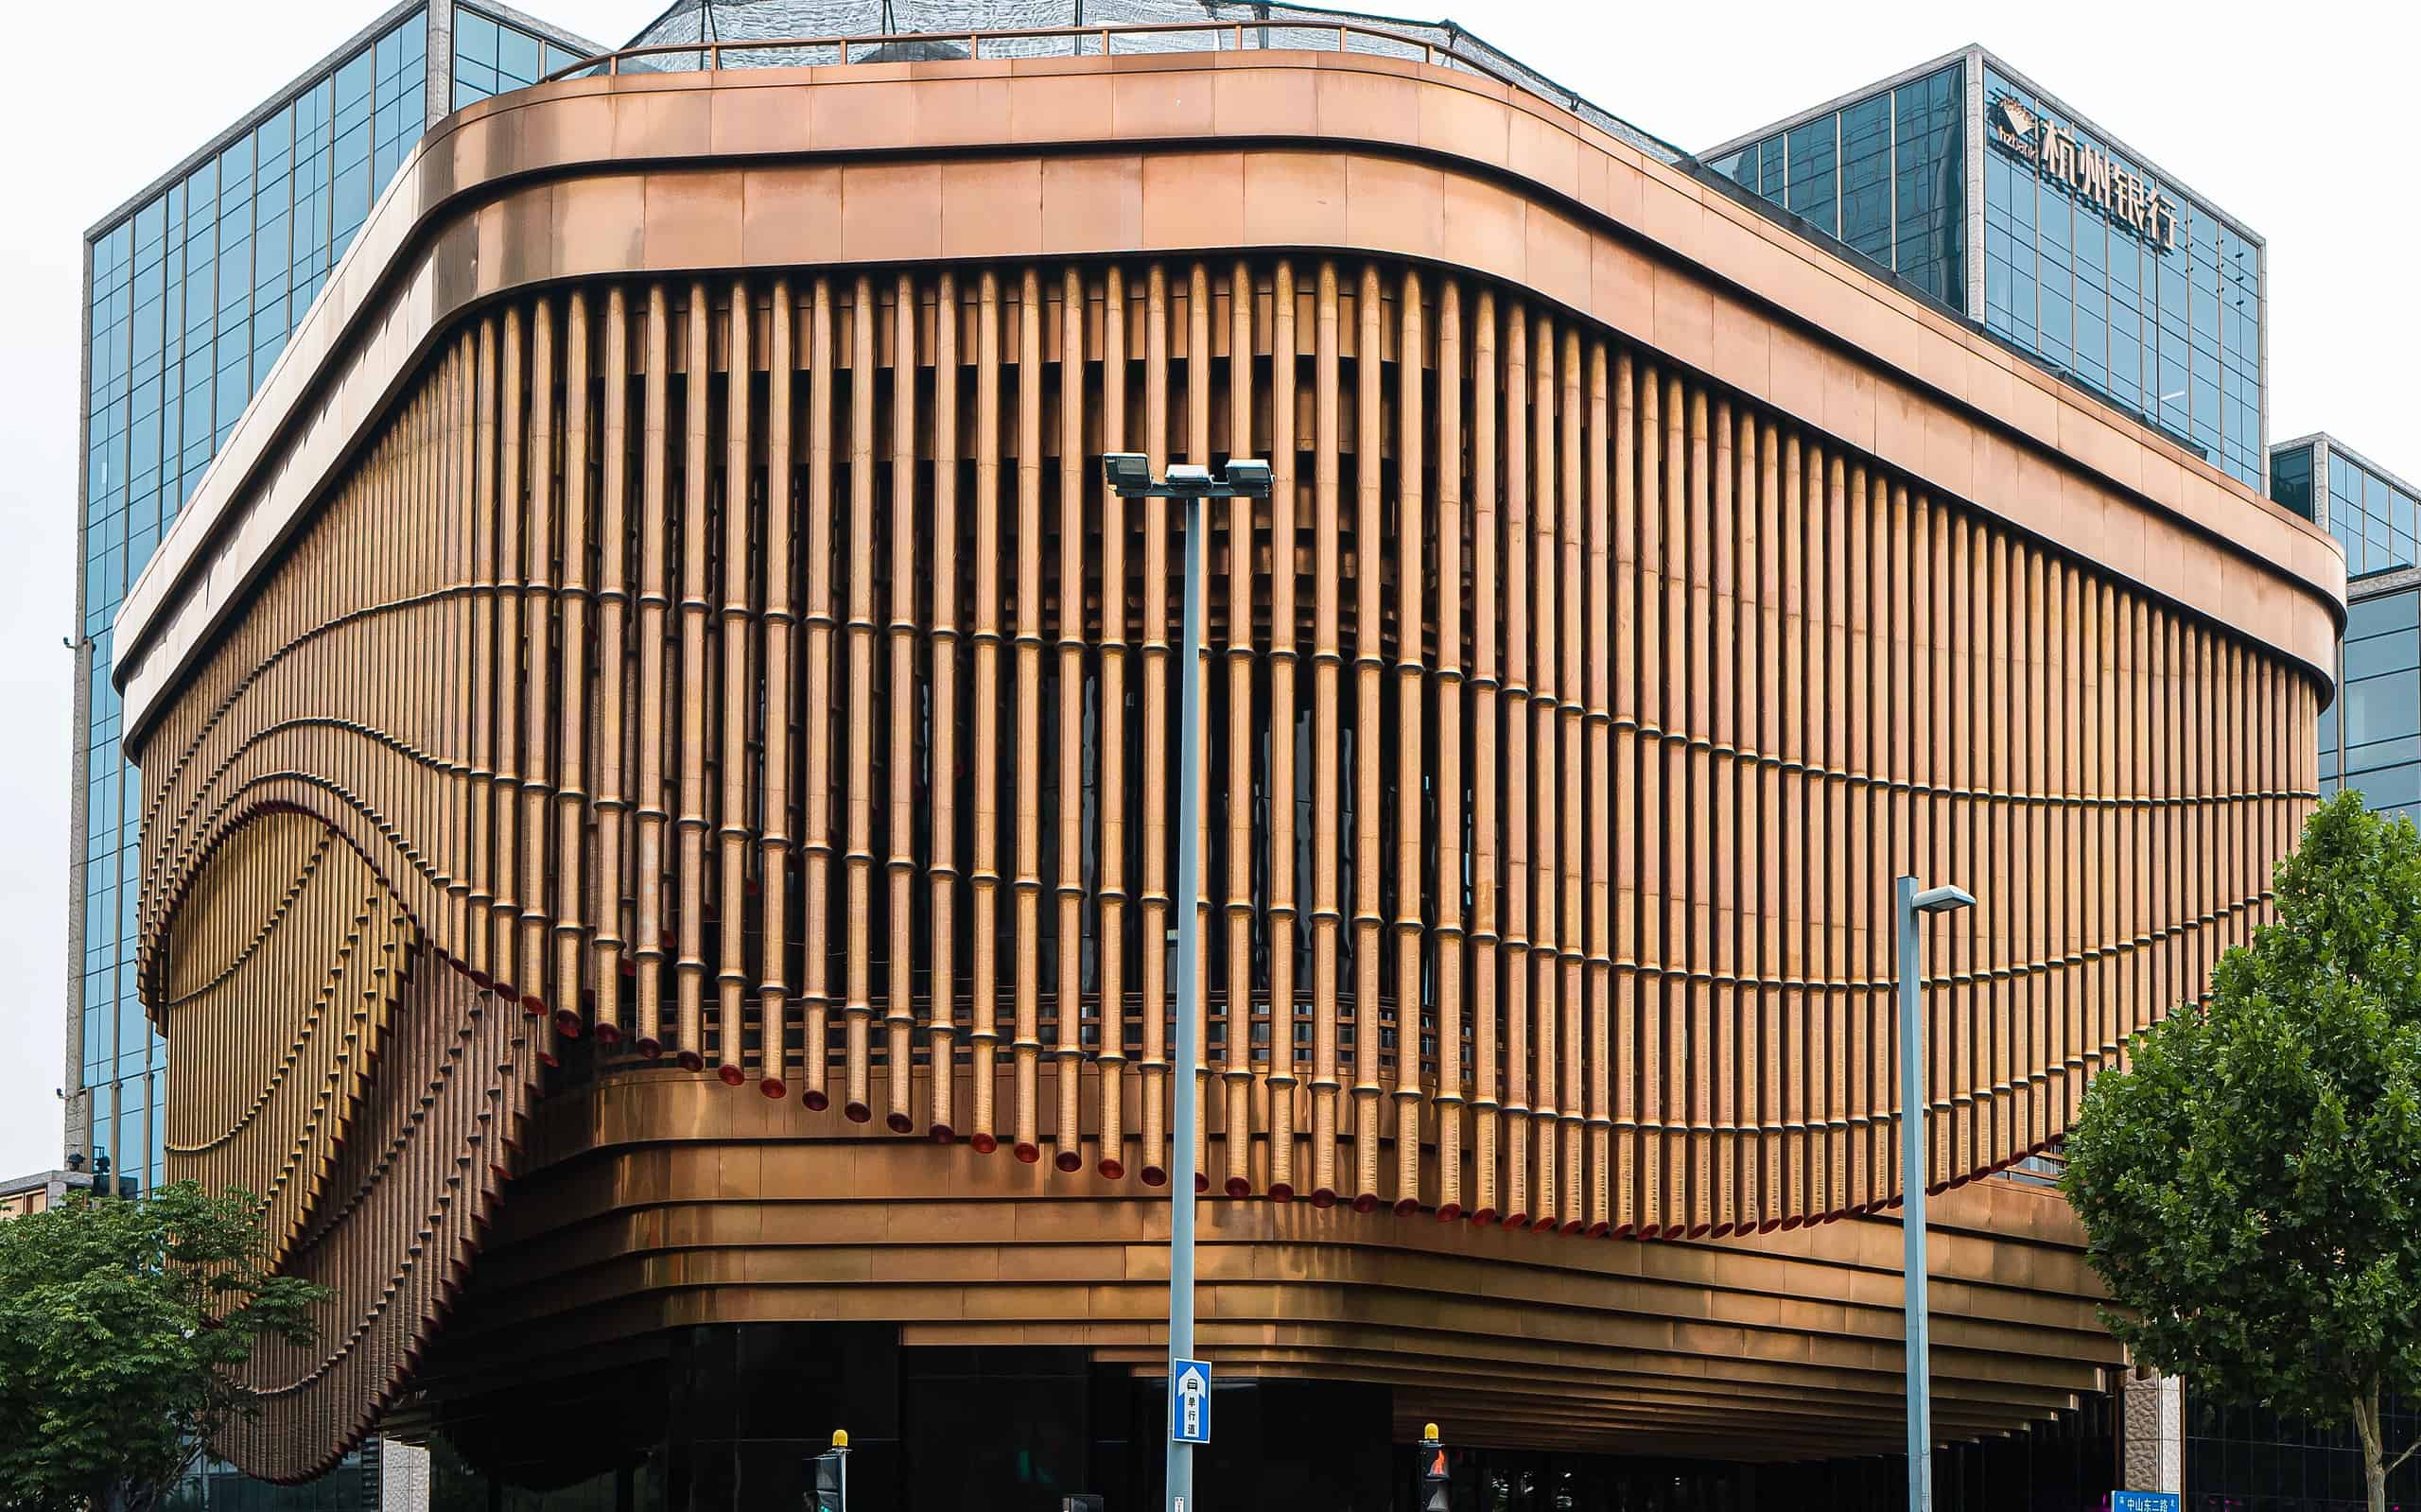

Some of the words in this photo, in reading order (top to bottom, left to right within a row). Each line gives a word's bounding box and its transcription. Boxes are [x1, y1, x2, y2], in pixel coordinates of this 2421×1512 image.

[1997, 126, 2037, 159] hzbank
[2041, 119, 2177, 250] 杭州银行
[2127, 1497, 2168, 1512] 中山东二路
